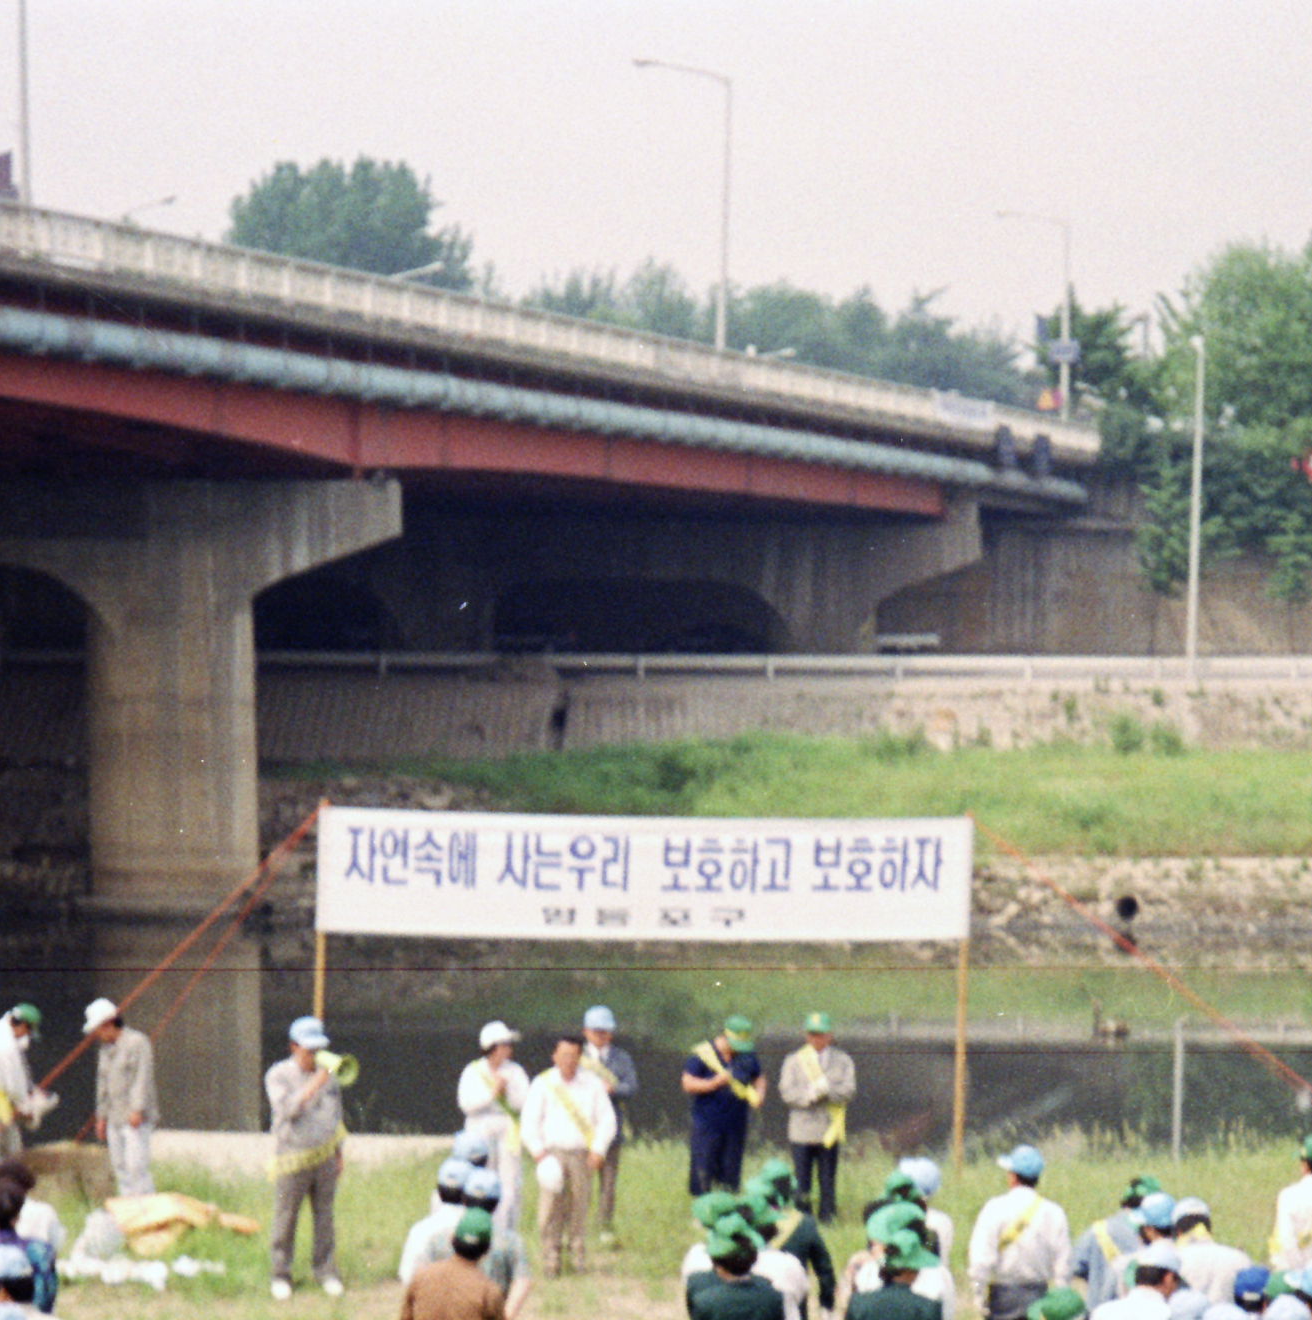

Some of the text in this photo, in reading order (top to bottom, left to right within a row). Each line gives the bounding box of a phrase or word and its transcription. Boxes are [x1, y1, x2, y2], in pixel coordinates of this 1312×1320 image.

[344, 827, 478, 889] 자연속에
[660, 836, 792, 894] 보호하고
[811, 836, 943, 893] 보호하자
